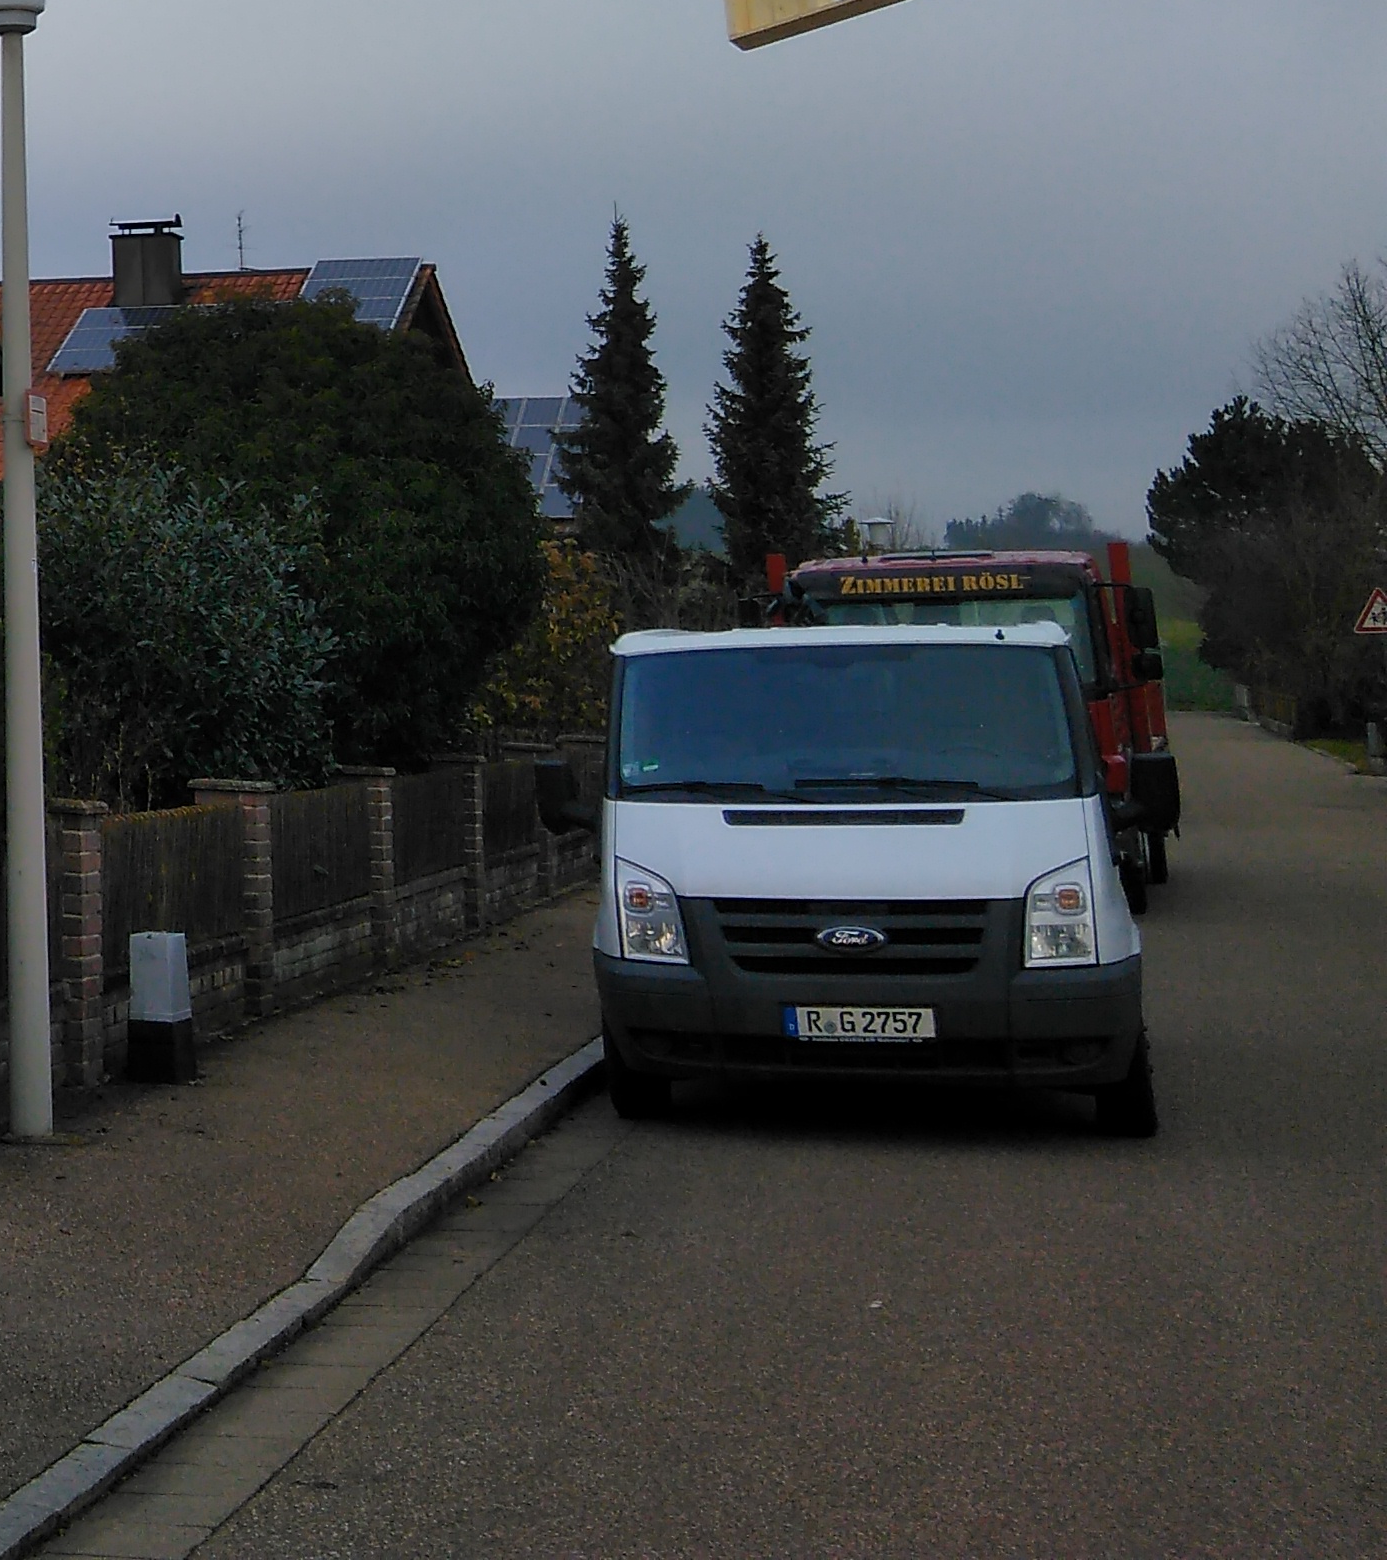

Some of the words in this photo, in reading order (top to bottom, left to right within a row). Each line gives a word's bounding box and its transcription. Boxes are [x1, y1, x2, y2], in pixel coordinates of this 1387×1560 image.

[840, 576, 956, 594] ZIMMEREI
[962, 572, 1024, 590] RÖSL
[831, 930, 869, 945] Ford
[806, 1010, 823, 1033] R
[839, 1011, 857, 1033] G
[861, 1011, 923, 1034] 2757
